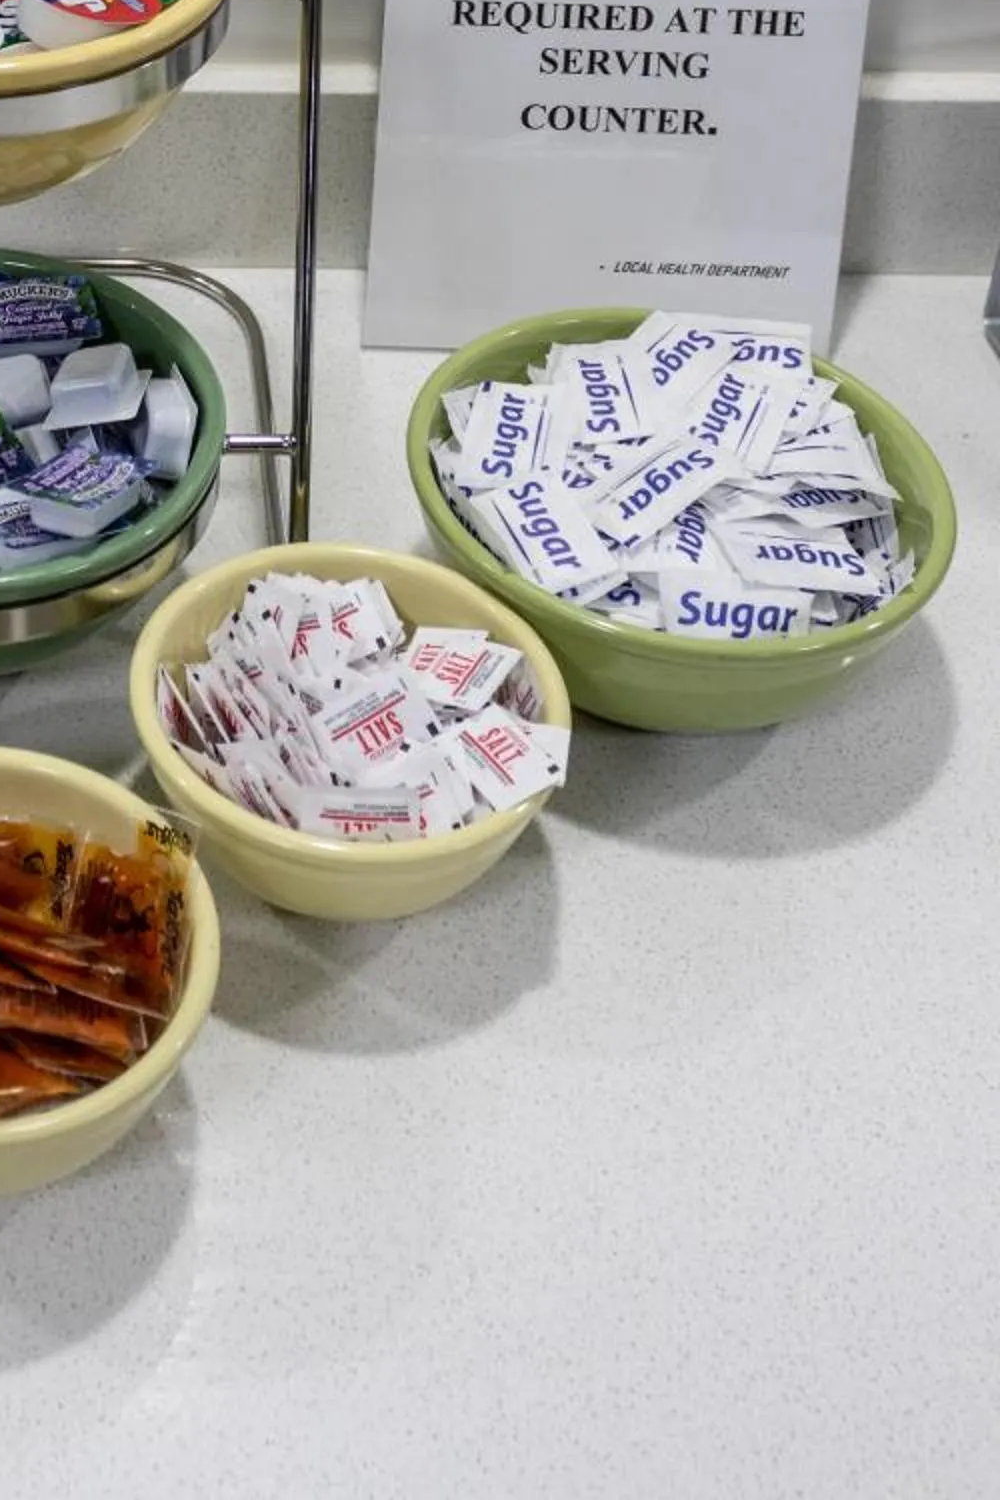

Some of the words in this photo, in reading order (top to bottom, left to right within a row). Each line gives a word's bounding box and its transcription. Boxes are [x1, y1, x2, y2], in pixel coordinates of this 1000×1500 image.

[452, 0, 654, 34] REQUIRED
[664, 6, 717, 34] AT
[728, 8, 806, 38] THE
[538, 47, 710, 80] SERVING
[520, 102, 719, 136] COUNTER.
[613, 261, 654, 275] LOCAL
[656, 263, 706, 276] HEALTH
[706, 264, 790, 279] DEPARTMENT
[652, 330, 715, 386] Suga
[731, 339, 804, 369] Sug
[578, 359, 621, 433] Sugar
[481, 392, 529, 478] Sugar
[618, 449, 715, 520] Sugar
[508, 481, 582, 569] Sugar
[756, 543, 866, 577] Sugar
[677, 591, 799, 639] Sugar
[436, 651, 475, 686] SALT
[356, 710, 404, 755] SALT
[478, 727, 526, 767] SALT
